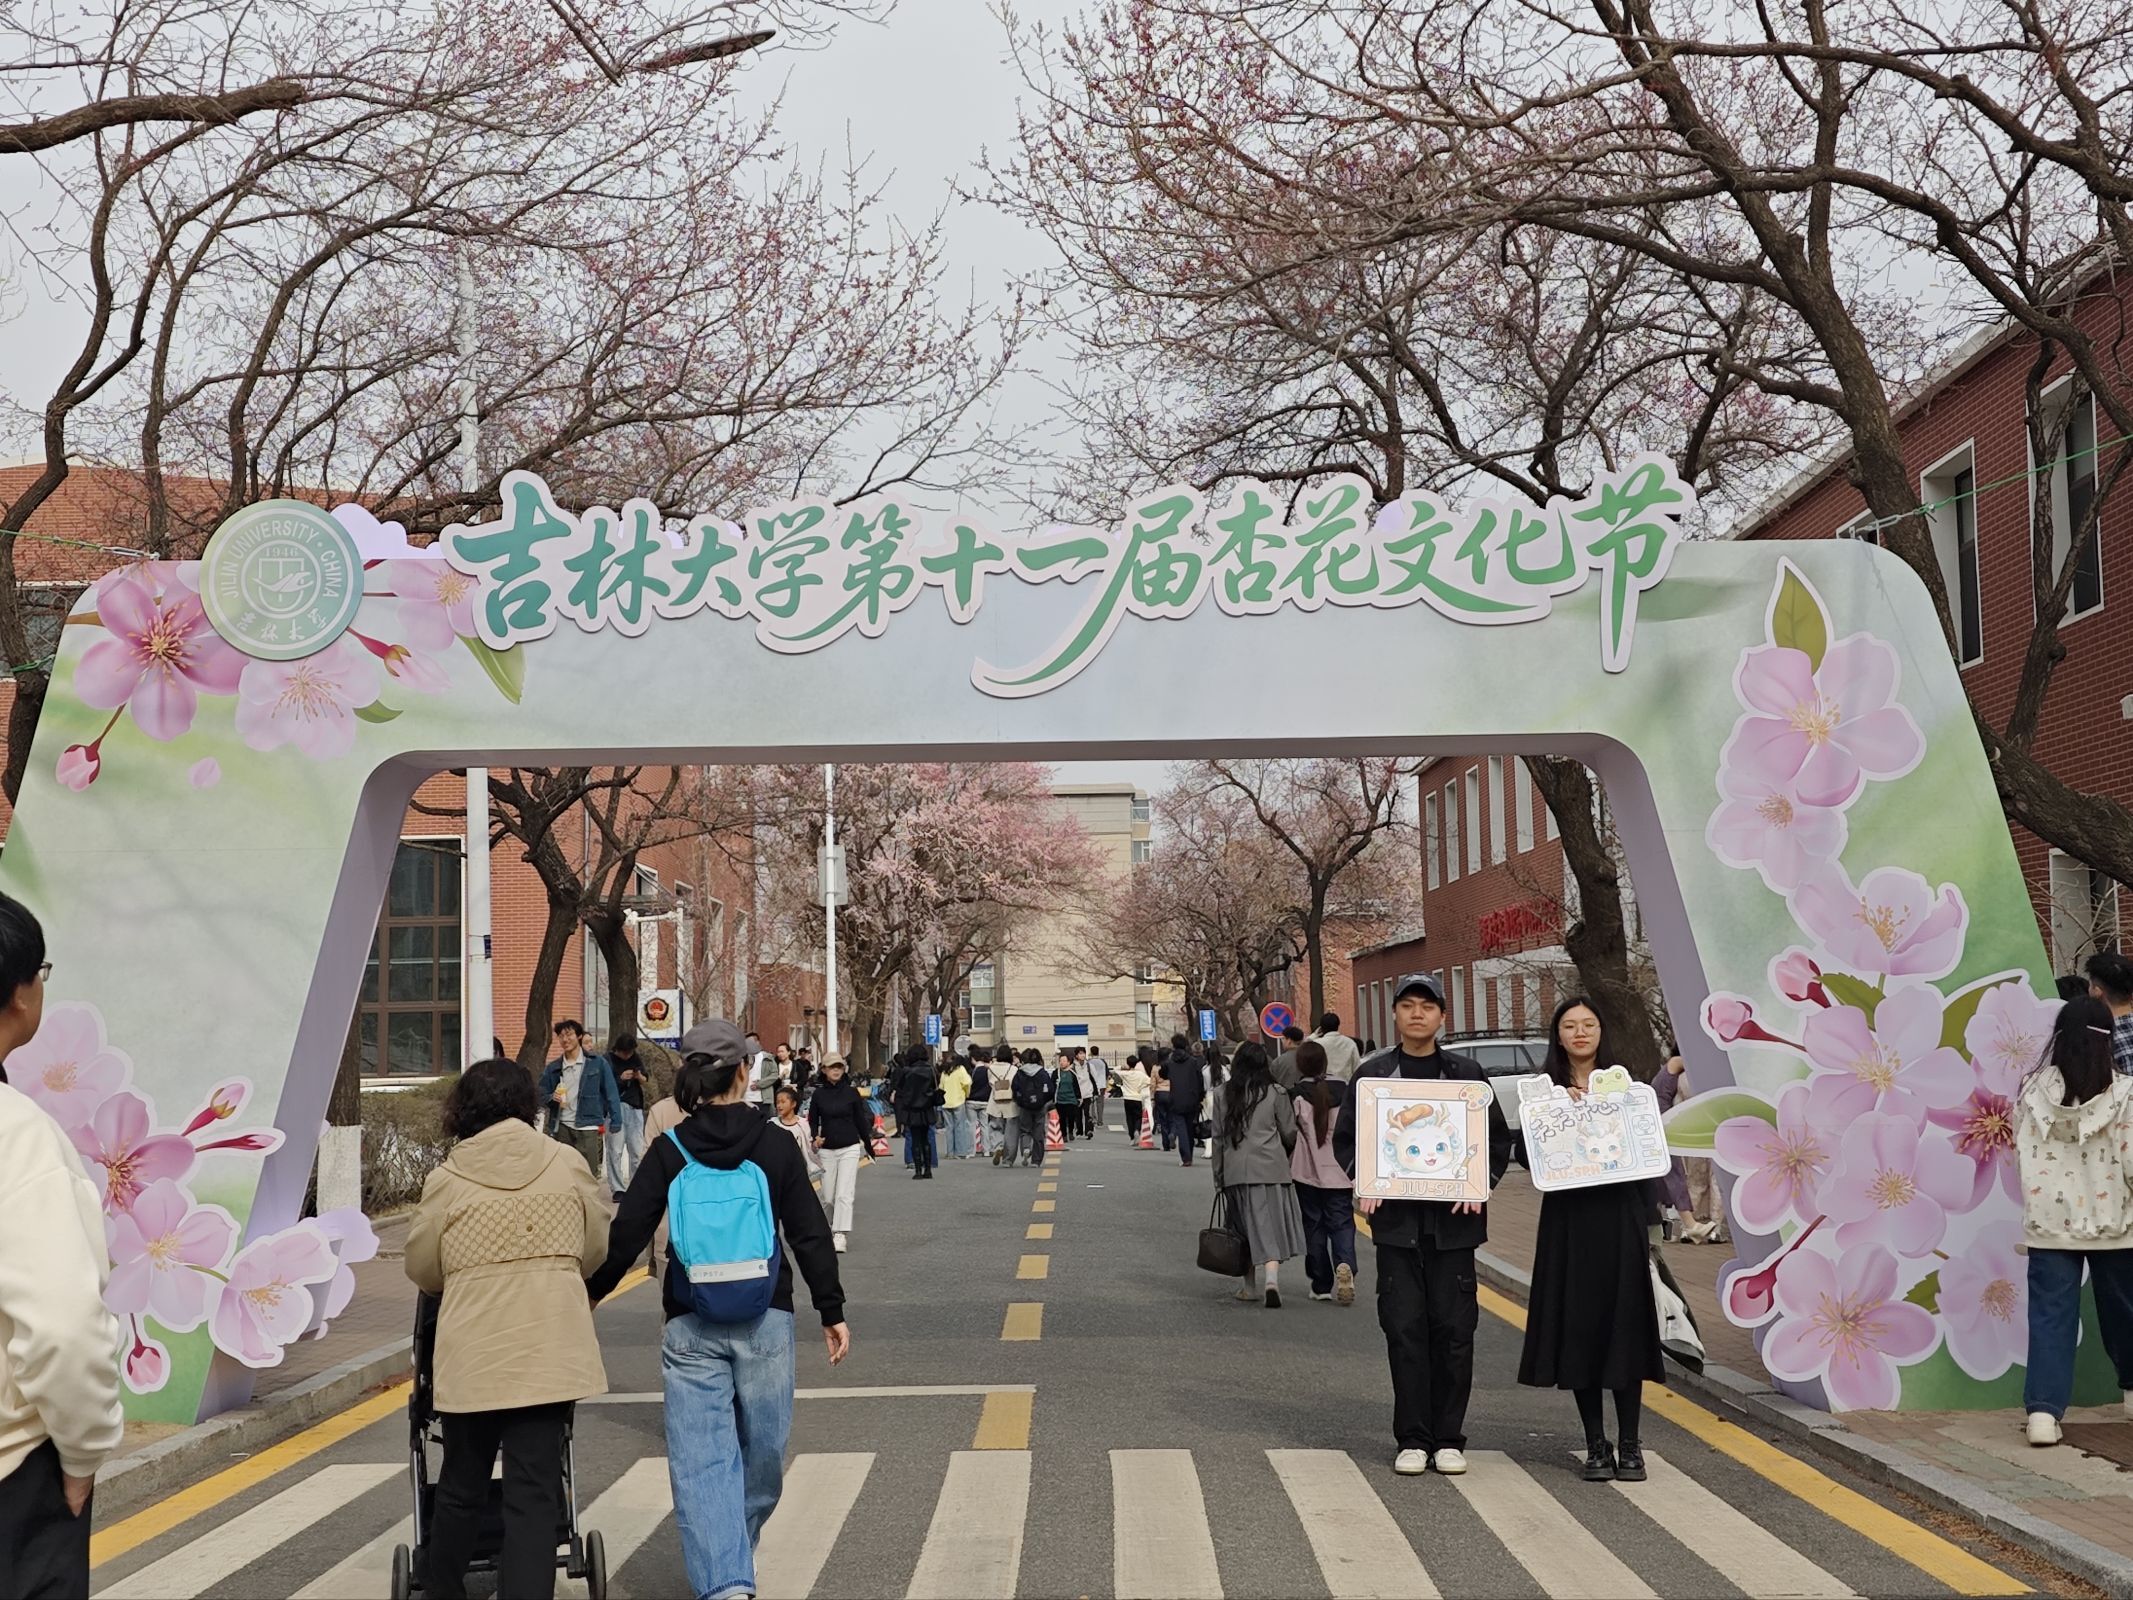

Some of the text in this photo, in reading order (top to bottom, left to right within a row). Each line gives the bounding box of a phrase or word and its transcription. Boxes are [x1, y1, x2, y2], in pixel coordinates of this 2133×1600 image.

[221, 519, 342, 598] JILIN UNIVERSITY CHINA
[265, 546, 299, 557] 1946
[452, 461, 1685, 687] 吉林大学第十一届杏花文化节
[1529, 1099, 1620, 1143] 天天开心
[1399, 1180, 1465, 1197] JLU-SPH
